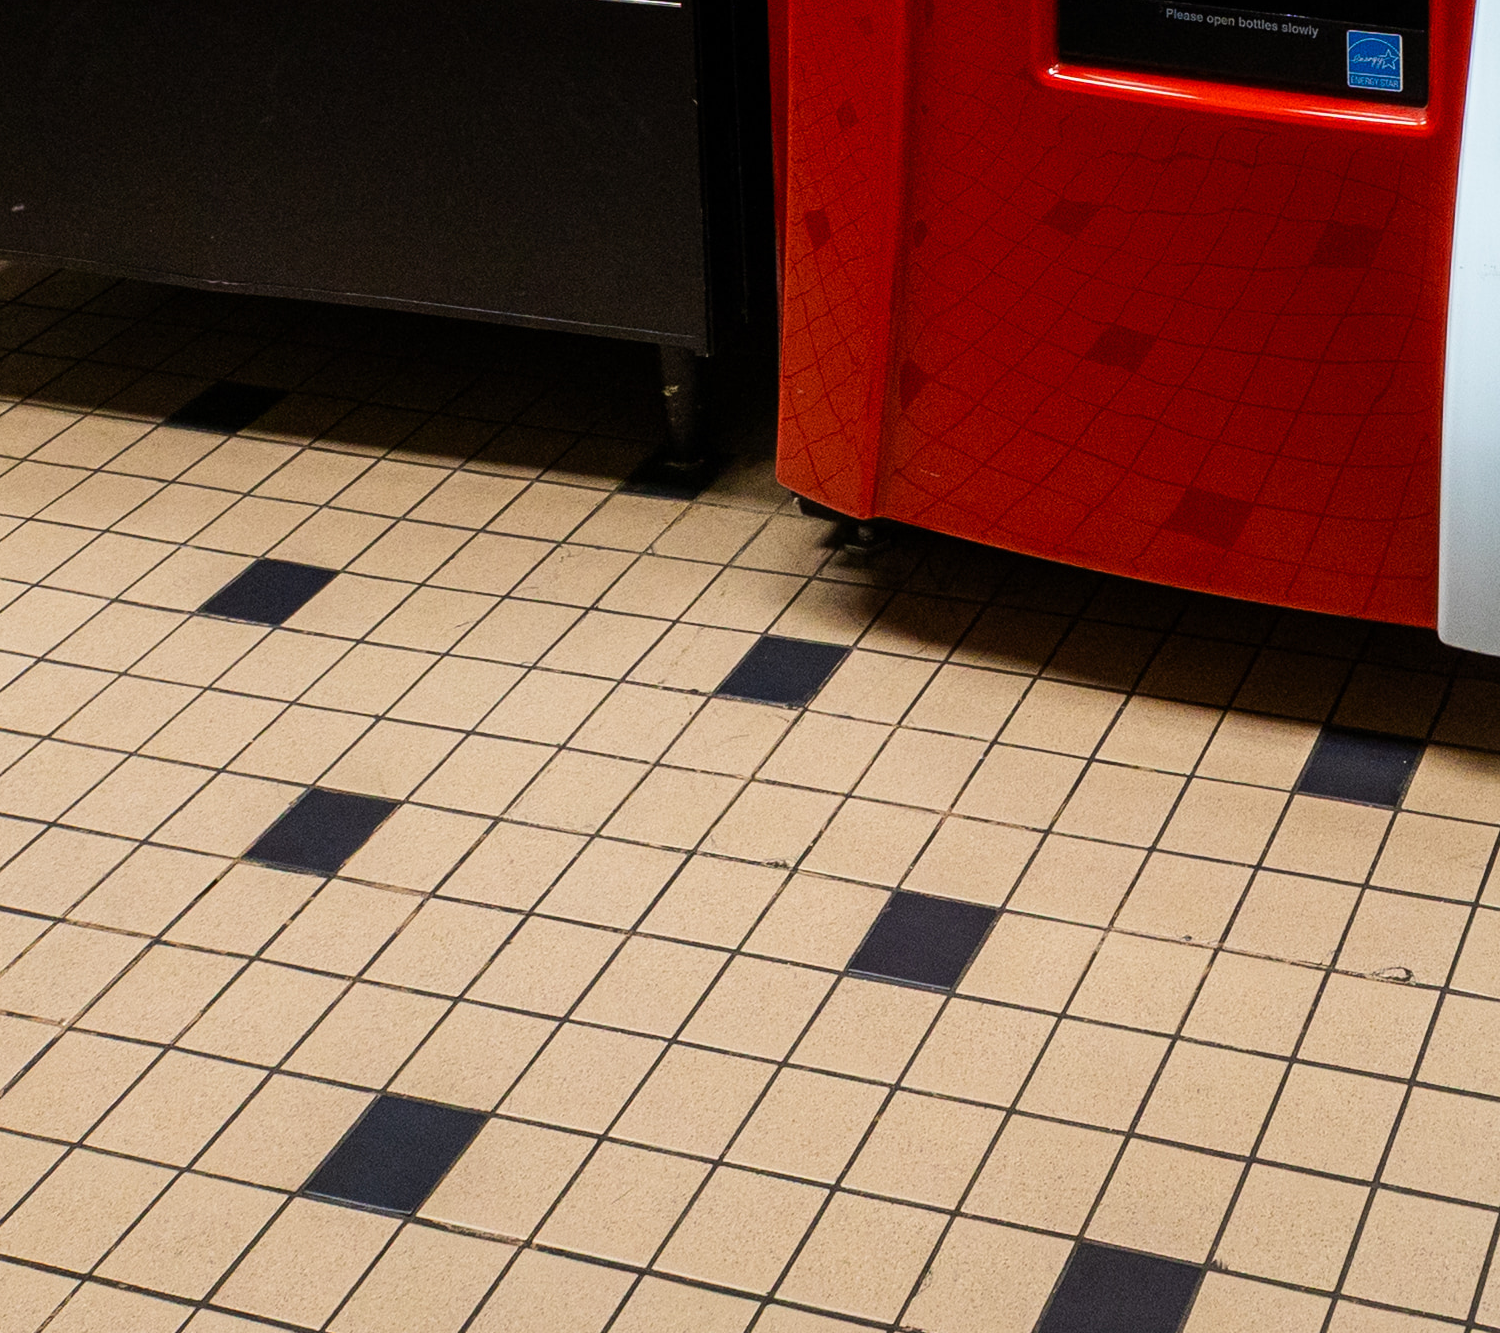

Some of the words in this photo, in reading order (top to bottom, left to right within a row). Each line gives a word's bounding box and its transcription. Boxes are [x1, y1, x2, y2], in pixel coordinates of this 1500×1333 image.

[1165, 8, 1204, 23] Please
[1206, 13, 1236, 29] open
[1238, 16, 1279, 32] bottles
[1281, 21, 1320, 39] slowly
[1350, 75, 1379, 87] ENERGY
[1380, 78, 1399, 88] STAR
